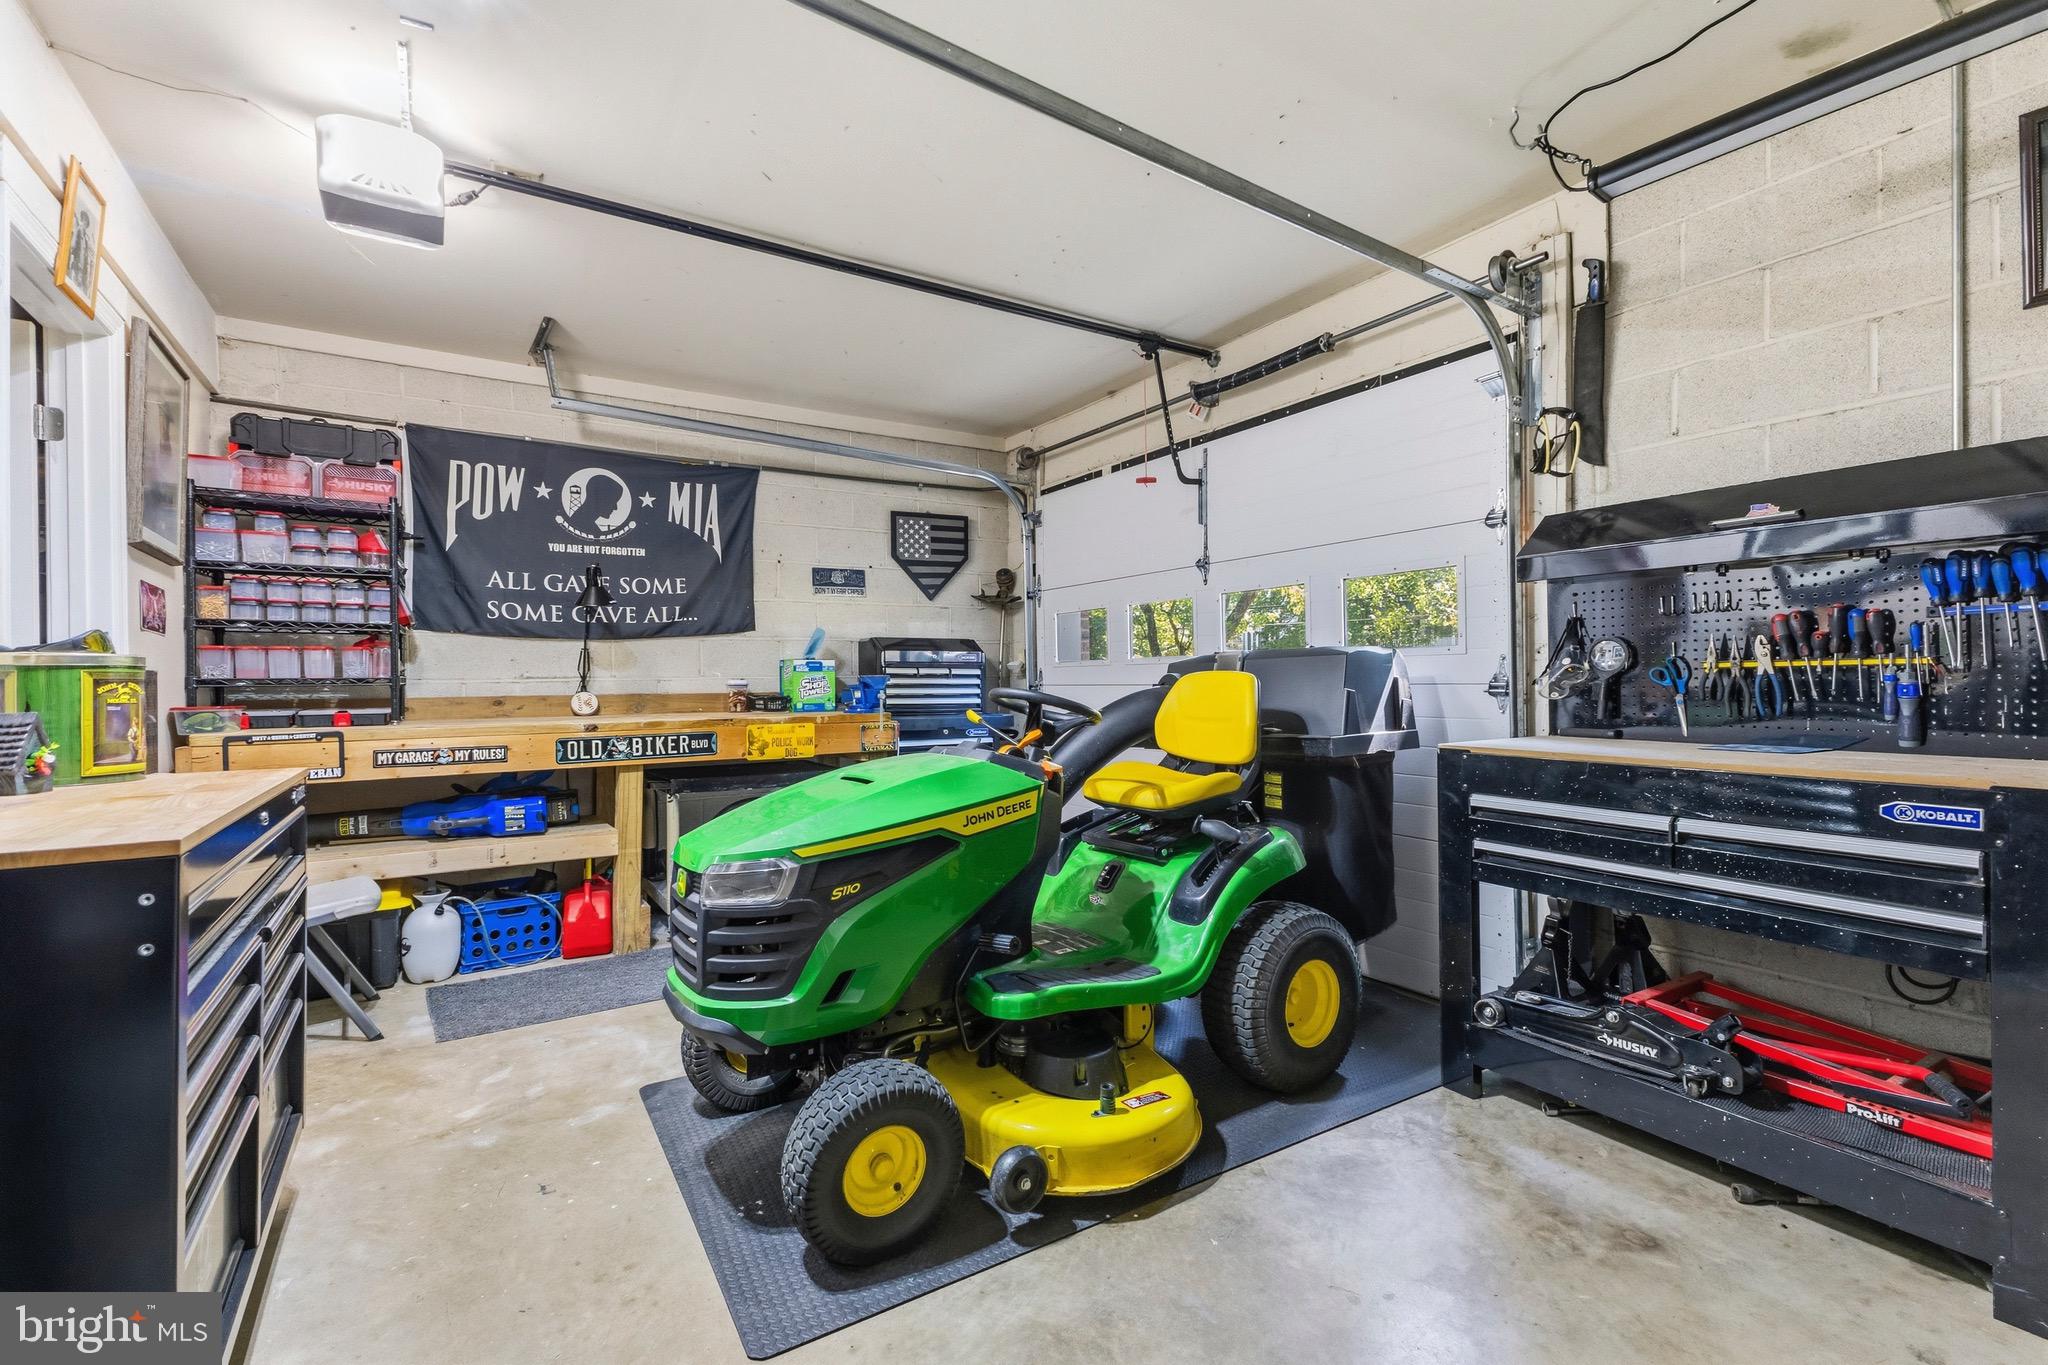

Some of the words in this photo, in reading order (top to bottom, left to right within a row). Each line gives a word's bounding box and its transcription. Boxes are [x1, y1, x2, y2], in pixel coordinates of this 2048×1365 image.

[344, 480, 393, 492] HUSKY
[445, 459, 526, 551] POW
[668, 481, 722, 565] MIA
[548, 542, 566, 553] YOU
[566, 544, 583, 554] ARE
[583, 545, 600, 555] NOT
[601, 546, 646, 557] FORGOTTEN
[486, 570, 536, 591] ALL
[619, 577, 687, 595] SOME
[487, 600, 563, 623] SOME
[571, 605, 637, 624] GAVE
[798, 687, 832, 699] TOWELS
[800, 677, 828, 690] SHOP
[567, 740, 602, 760] OLD
[632, 735, 690, 756] BIKER
[690, 739, 709, 749] BLVD
[771, 736, 793, 748] POLICE
[796, 735, 814, 746] WORK
[377, 752, 395, 765] MY
[395, 751, 434, 764] GARAGE
[454, 750, 471, 762] MY
[472, 748, 505, 761] RULES!
[962, 810, 995, 828] JOHN
[996, 799, 1032, 818] DEERE
[1915, 809, 1974, 824] KOBALT
[831, 882, 862, 901] S110
[1612, 1037, 1658, 1059] HUSKY
